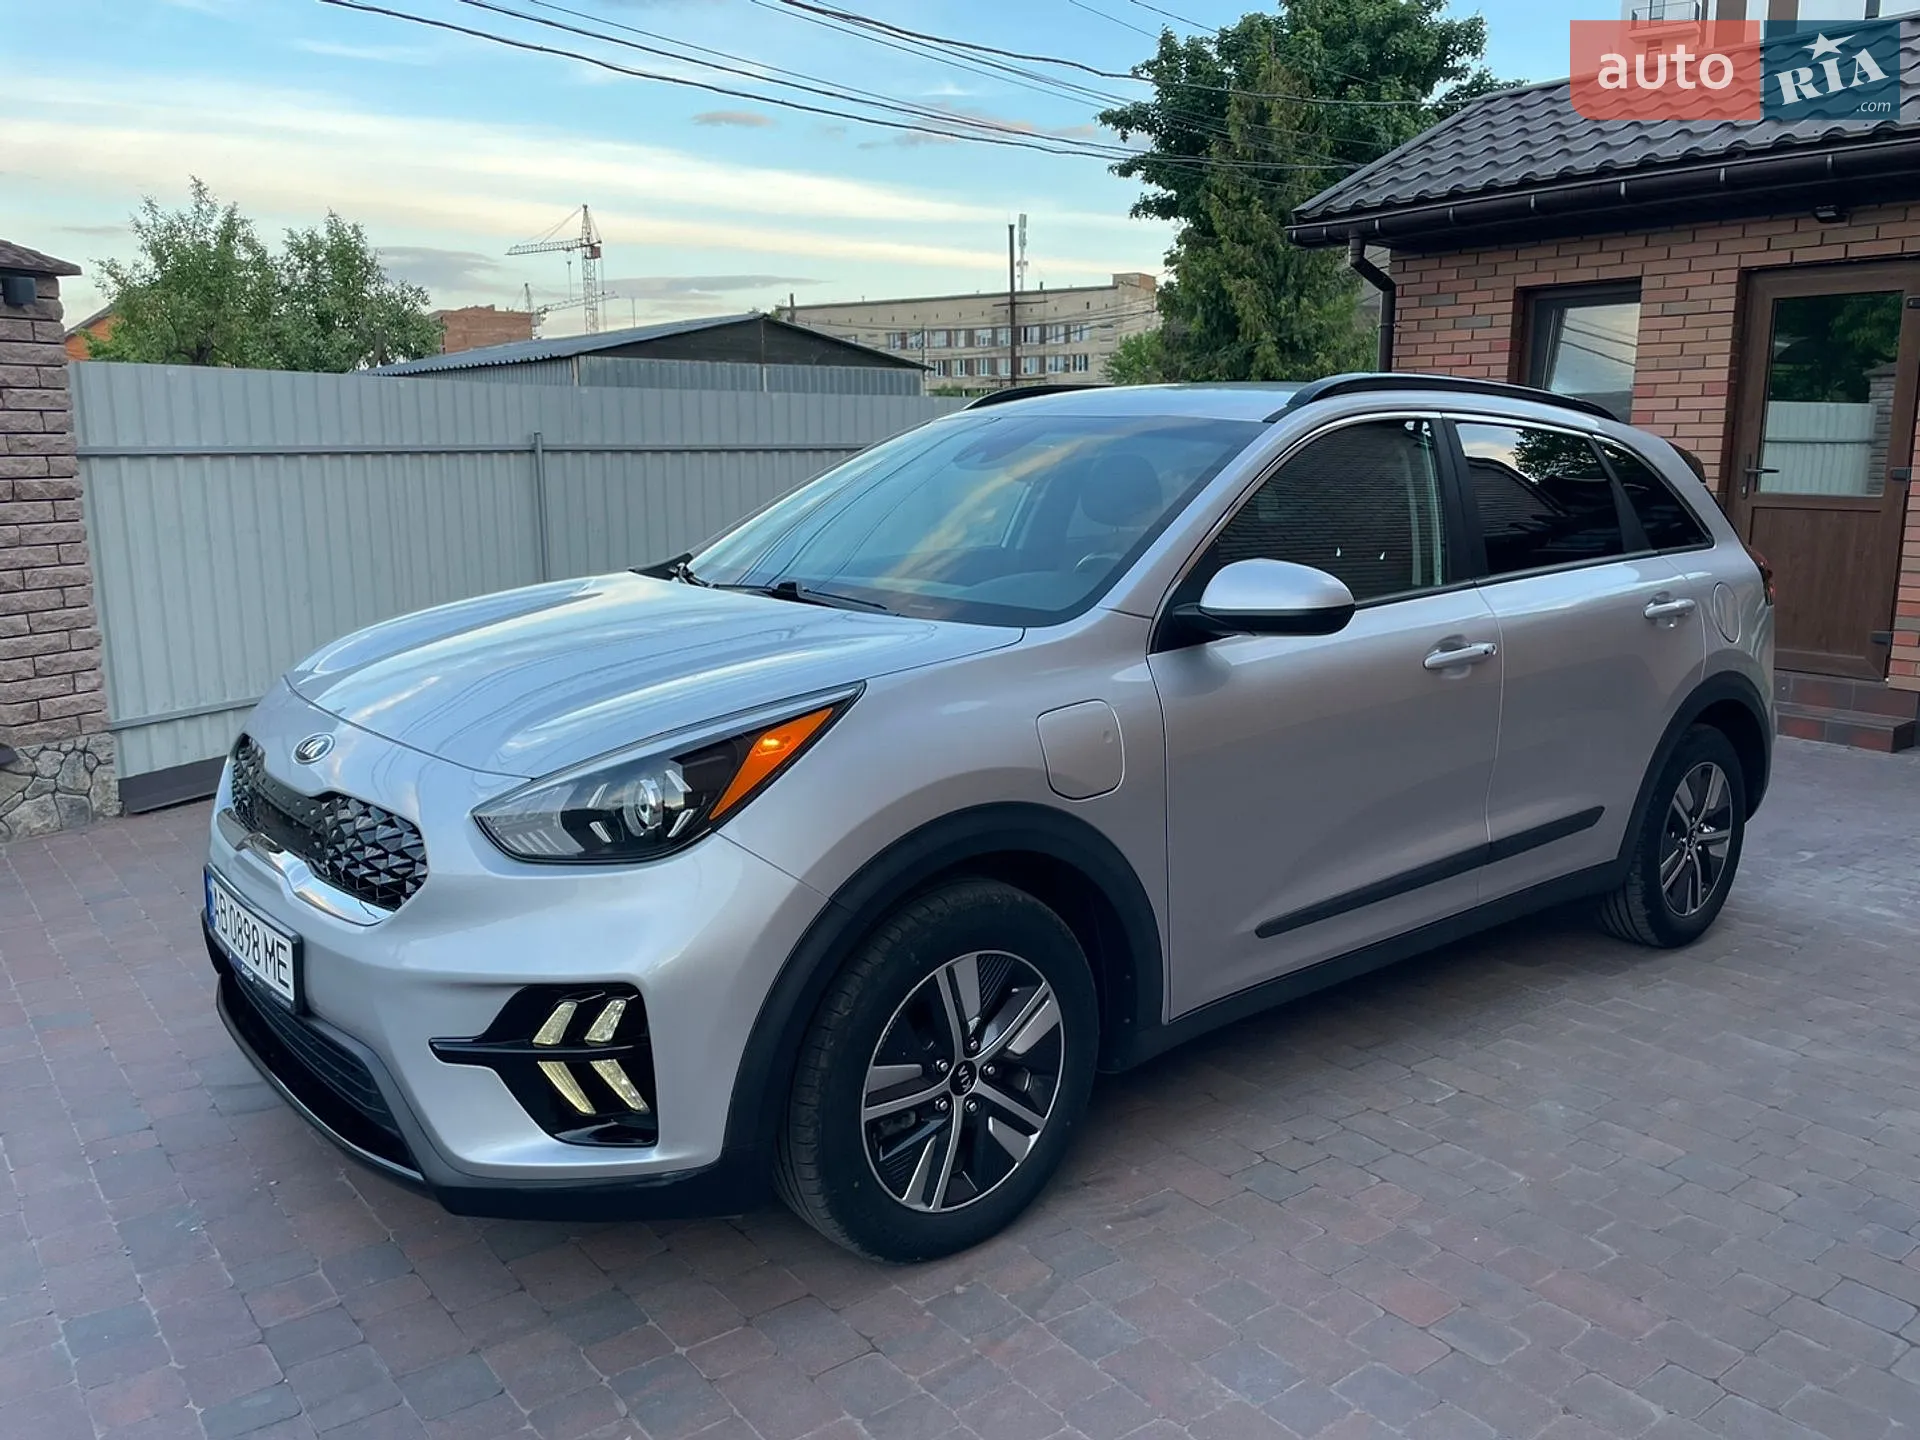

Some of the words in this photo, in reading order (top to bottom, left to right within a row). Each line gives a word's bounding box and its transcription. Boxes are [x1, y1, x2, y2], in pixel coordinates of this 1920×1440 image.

[229, 904, 261, 966] 0898
[264, 931, 290, 989] ME
[958, 1065, 972, 1092] KIA
